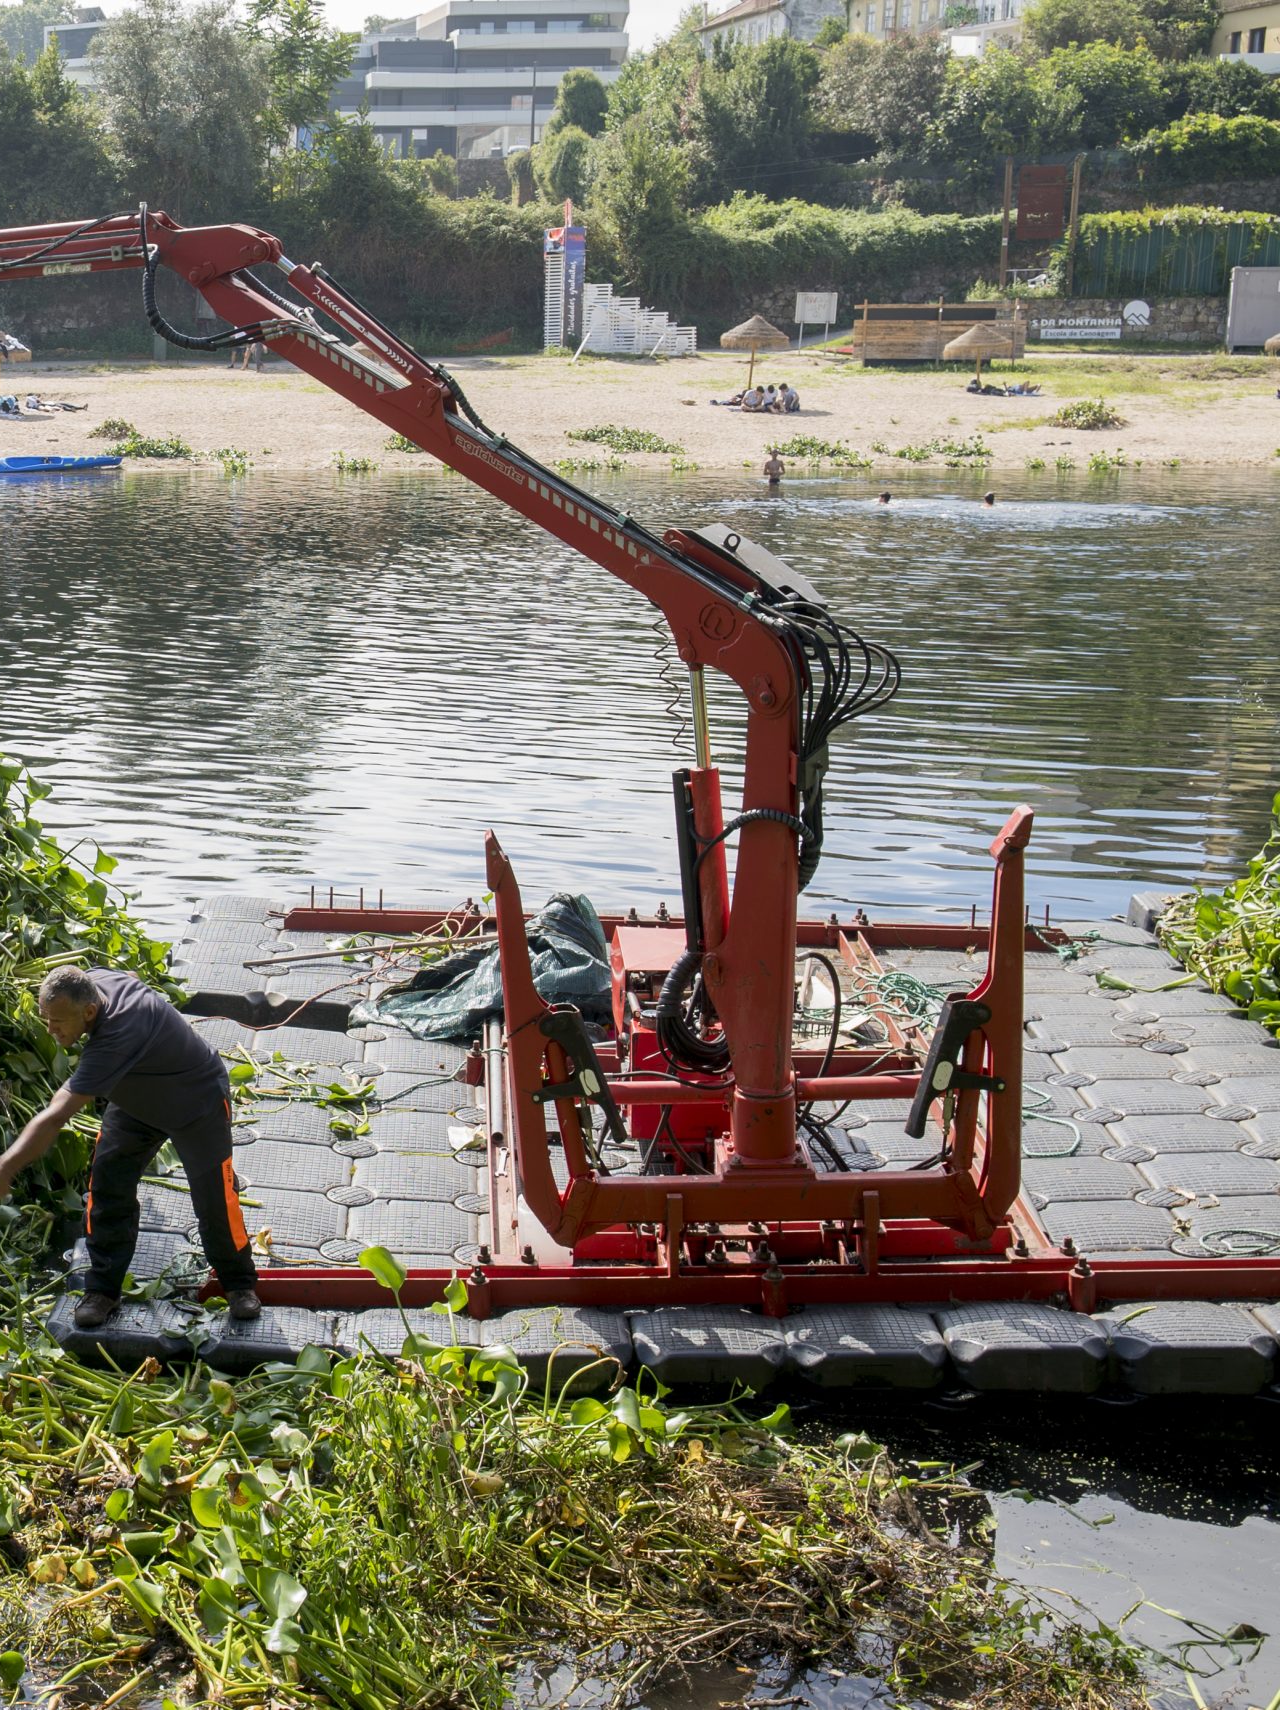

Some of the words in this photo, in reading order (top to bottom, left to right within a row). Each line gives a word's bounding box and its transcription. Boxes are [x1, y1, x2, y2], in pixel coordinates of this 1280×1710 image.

[1040, 318, 1056, 327] DA
[1058, 318, 1122, 327] MONTANHA
[1045, 329, 1067, 337] Escola
[1068, 329, 1077, 337] de
[455, 434, 525, 485] agriduarte
